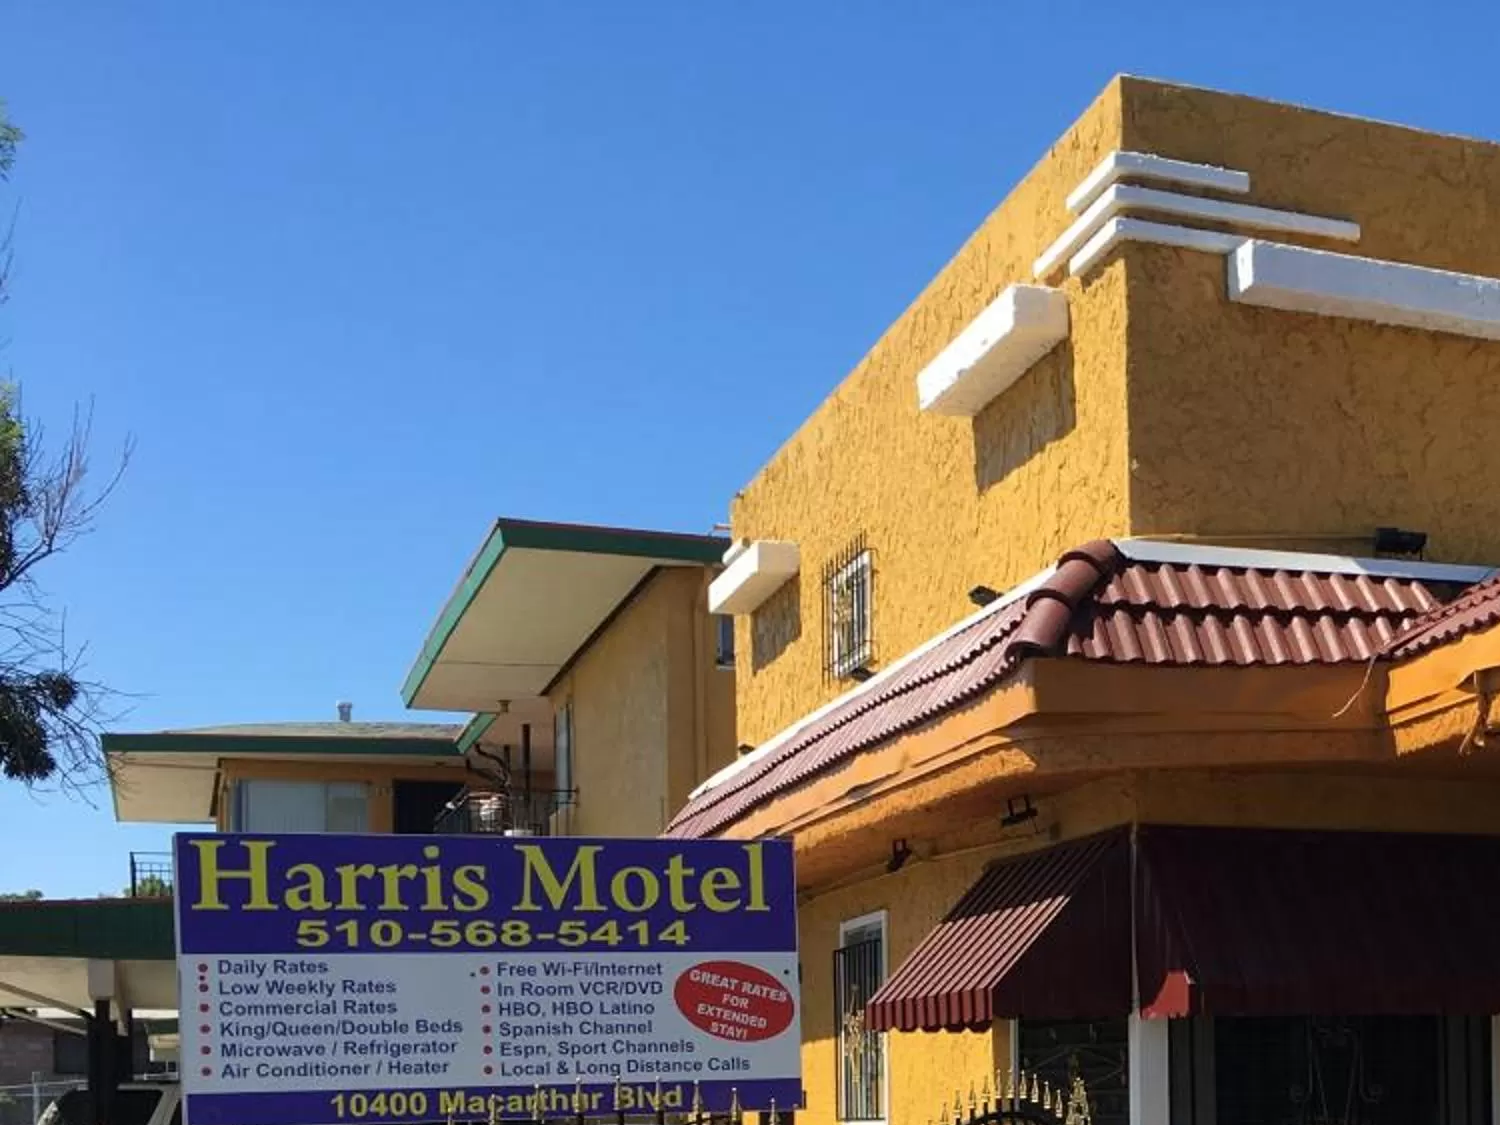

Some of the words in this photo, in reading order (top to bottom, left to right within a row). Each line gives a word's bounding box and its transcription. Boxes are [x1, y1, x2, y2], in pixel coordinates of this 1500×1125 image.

[188, 839, 491, 913] Harris
[512, 842, 773, 913] Motel
[295, 919, 692, 948] 510-568-5414
[217, 959, 267, 978] Daily
[273, 960, 329, 974] Rates
[497, 962, 537, 977] Free
[219, 980, 260, 996] Low
[265, 979, 336, 998] Weekly
[341, 979, 398, 994] Rates
[497, 982, 515, 997] In
[520, 983, 575, 997] Room
[579, 981, 664, 996] VCR/DVD
[689, 969, 739, 991] GREAT
[741, 981, 788, 1003] RATES
[219, 1000, 338, 1017] Commercial
[343, 1000, 398, 1015] Rates
[498, 1001, 547, 1018] HBO,
[551, 1000, 594, 1016] HBO
[599, 1000, 656, 1015] Latino
[721, 993, 749, 1009] FOR
[696, 1003, 768, 1029] EXTENDED
[219, 1020, 410, 1041] King/Queen/Double
[415, 1019, 464, 1034] Beds
[499, 1021, 574, 1039] Spanish
[579, 1019, 653, 1035] Channel
[220, 1042, 327, 1058] Microwave
[331, 1043, 338, 1057] /
[343, 1040, 459, 1059] Refrigerator
[557, 1041, 611, 1058] Sport
[613, 1039, 696, 1055] Channels
[221, 1062, 251, 1080] Air
[255, 1061, 372, 1078] Conditioner
[375, 1060, 383, 1076] /
[387, 1059, 450, 1076] Heater
[500, 1061, 551, 1077] Local
[556, 1061, 570, 1076] &
[575, 1060, 621, 1079] Long
[626, 1058, 704, 1075] Distance
[707, 1056, 751, 1073] Calls
[330, 1091, 428, 1118] 10400
[615, 1084, 684, 1110] Blvd
